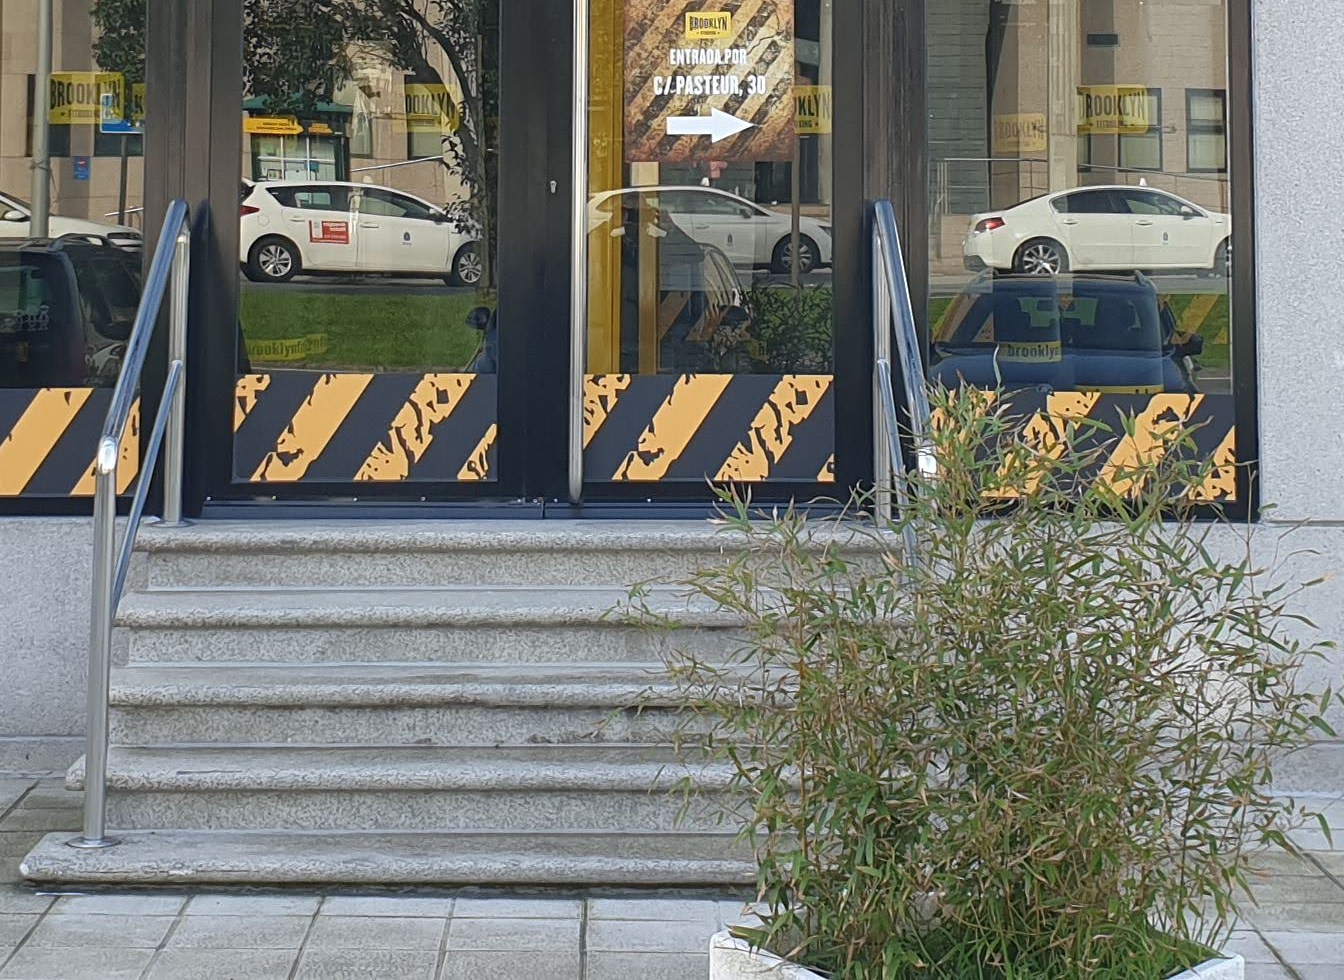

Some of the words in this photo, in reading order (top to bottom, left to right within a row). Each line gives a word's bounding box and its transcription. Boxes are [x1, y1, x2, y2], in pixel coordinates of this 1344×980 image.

[689, 15, 729, 32] BROOKLYN
[668, 48, 721, 66] ENTRADA
[724, 48, 748, 65] POR
[653, 75, 674, 96] C/
[674, 75, 744, 97] PASTEUR,
[747, 75, 767, 96] 30
